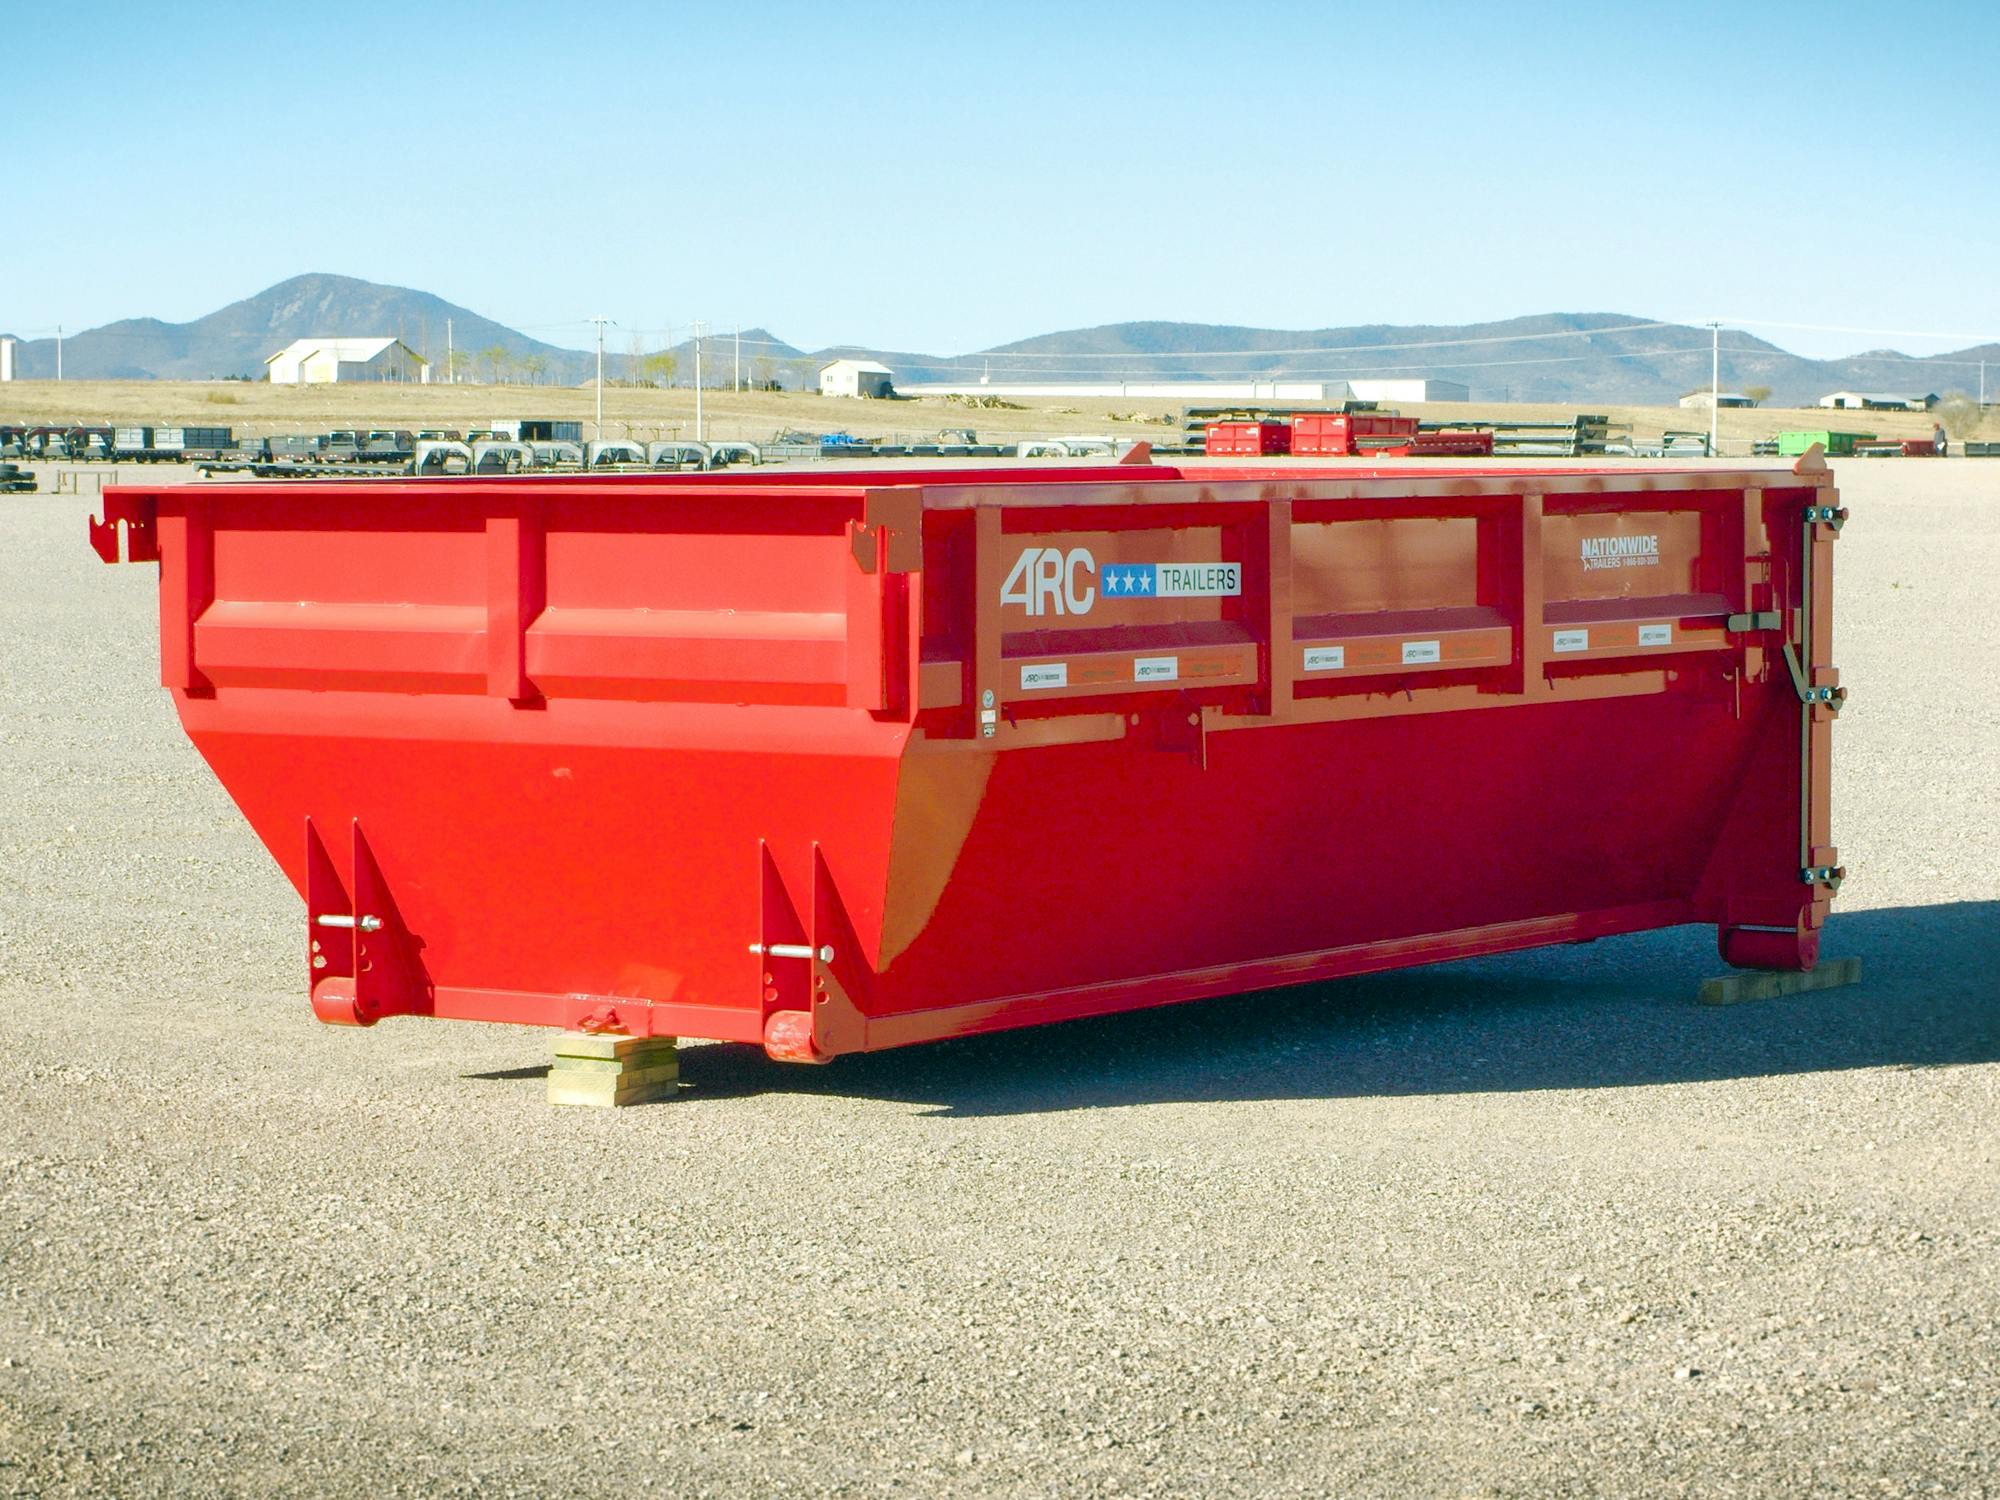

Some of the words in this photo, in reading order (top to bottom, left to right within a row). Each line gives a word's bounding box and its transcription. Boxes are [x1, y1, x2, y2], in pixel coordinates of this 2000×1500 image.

[1581, 535, 1658, 556] NATIONWIDE
[1590, 557, 1621, 569] TRAILERS
[1000, 547, 1096, 616] ARC
[1162, 568, 1236, 591] TRAILERS
